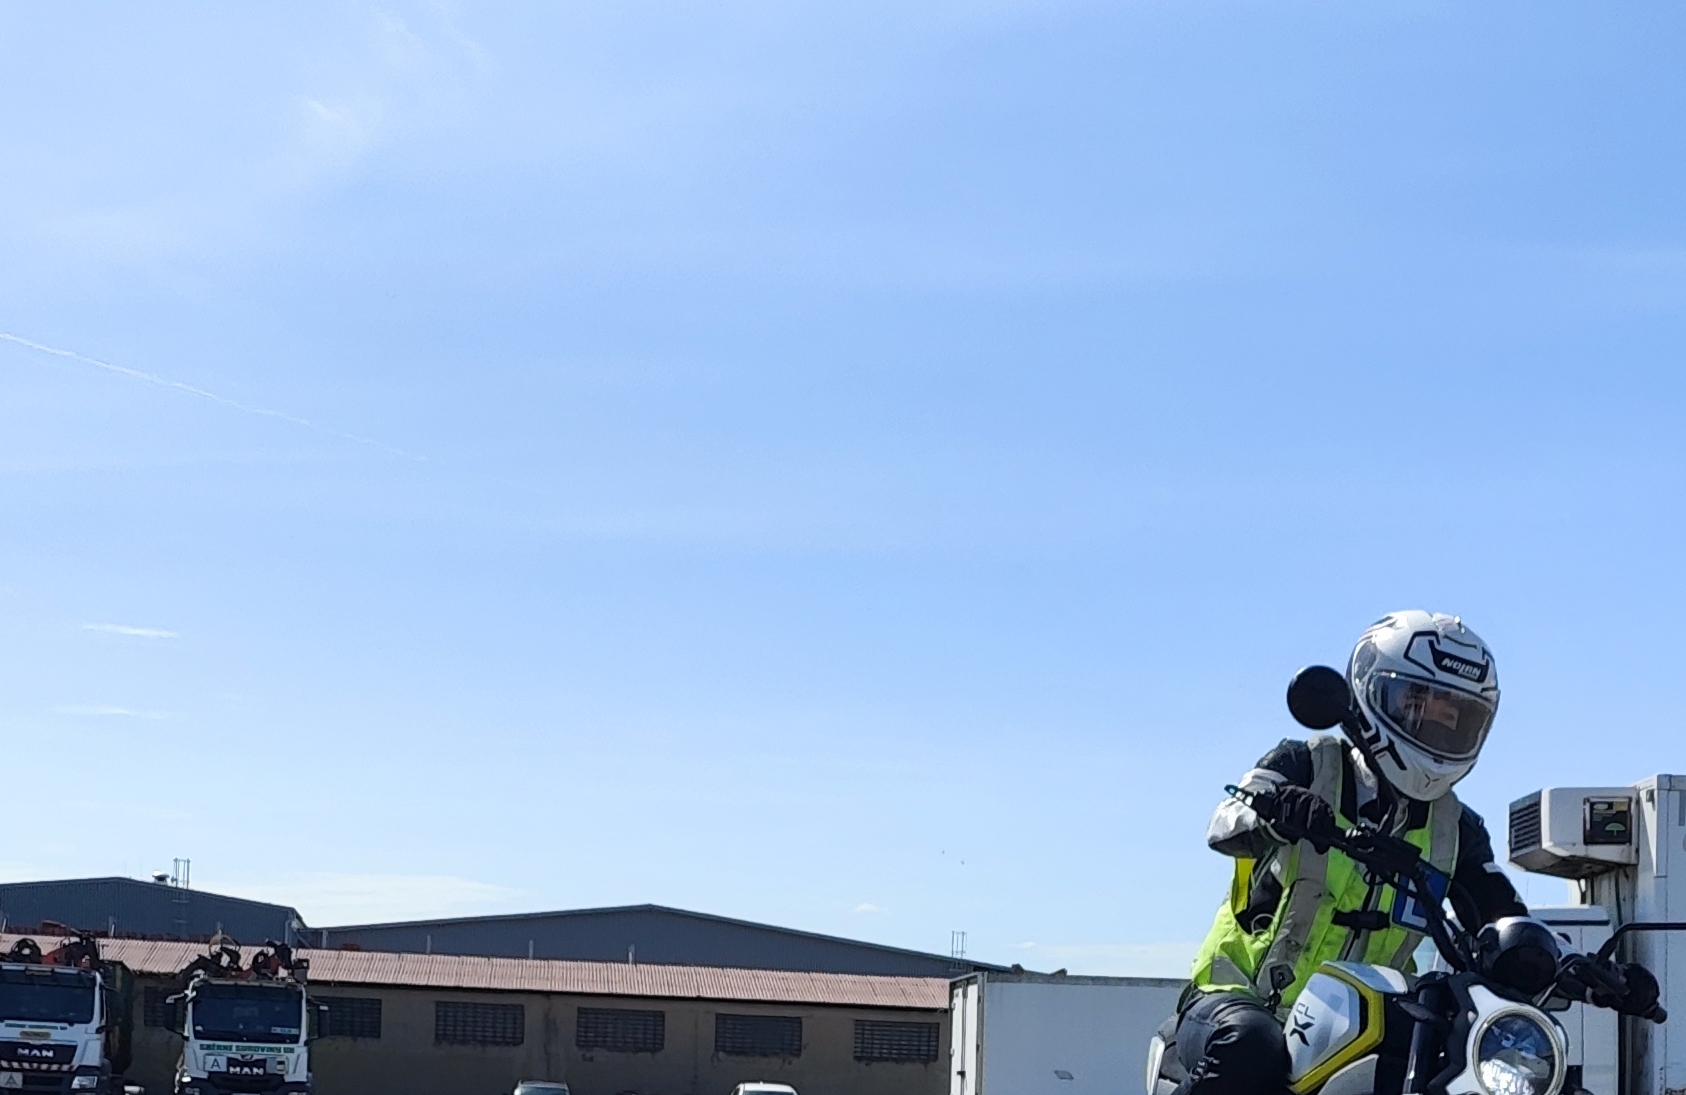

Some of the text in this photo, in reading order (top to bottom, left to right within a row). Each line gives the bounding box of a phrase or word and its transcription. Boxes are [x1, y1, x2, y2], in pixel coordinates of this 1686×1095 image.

[17, 1048, 54, 1058] MAN
[211, 1057, 222, 1070] A
[229, 1066, 264, 1076] MAN
